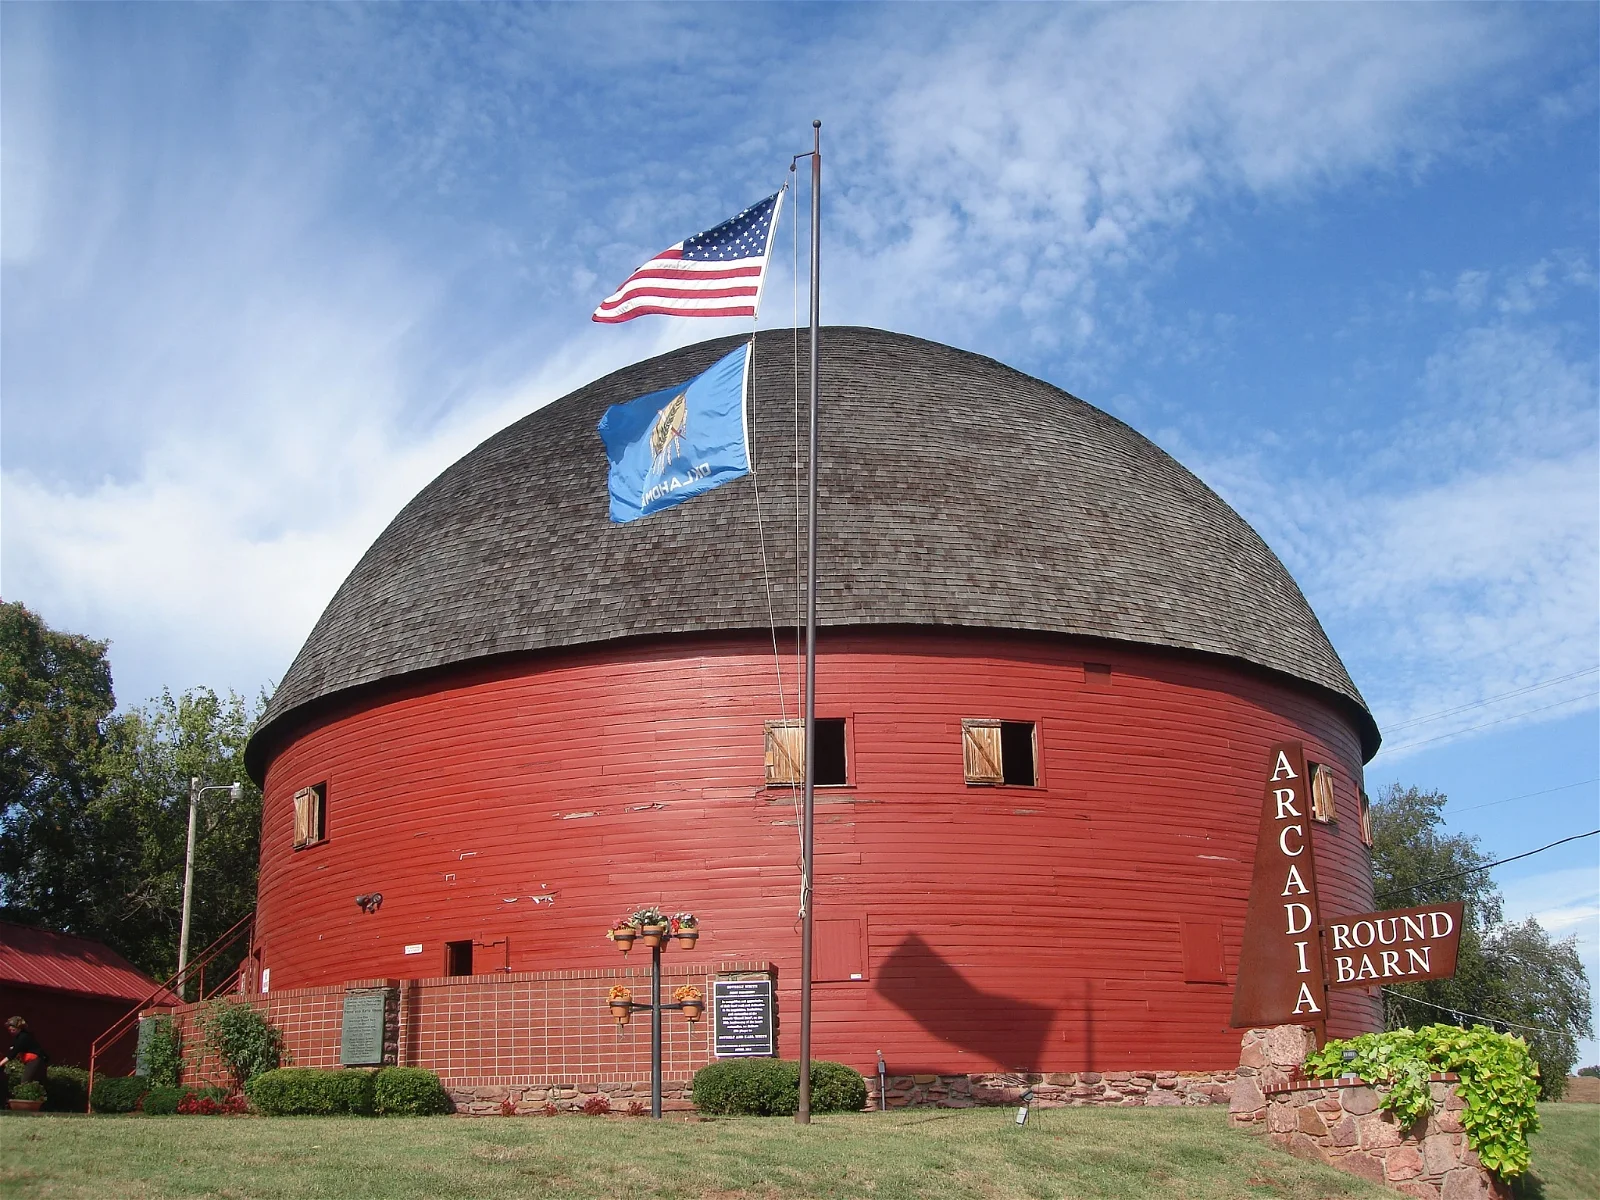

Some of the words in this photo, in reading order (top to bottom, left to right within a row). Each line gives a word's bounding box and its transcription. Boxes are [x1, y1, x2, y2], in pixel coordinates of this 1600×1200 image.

[1270, 750, 1321, 1014] ARCADIA
[1330, 911, 1453, 951] ROUND
[1335, 946, 1432, 983] BARN
